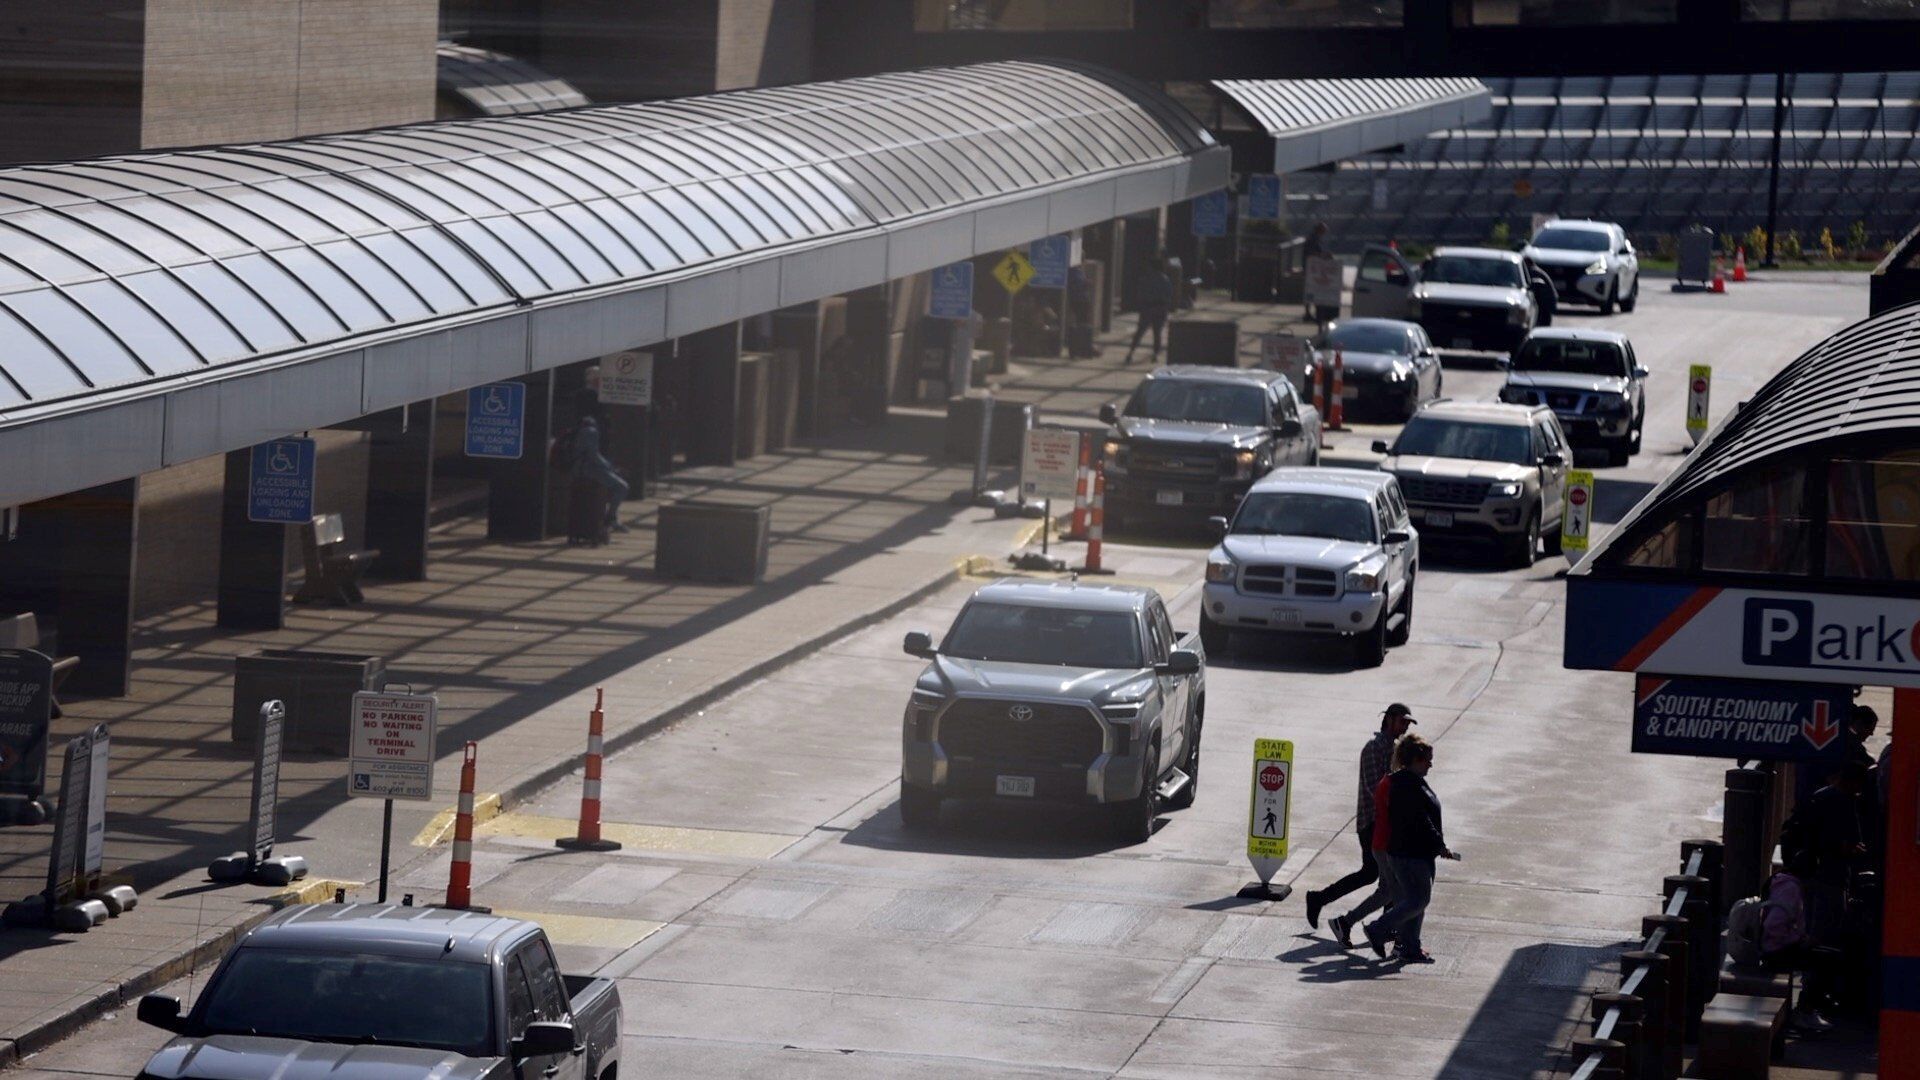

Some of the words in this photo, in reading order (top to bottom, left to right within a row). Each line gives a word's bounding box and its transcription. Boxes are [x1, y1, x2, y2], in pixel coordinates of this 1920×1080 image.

[256, 477, 307, 488] ACCESSIBLE
[252, 487, 289, 498] LOADING
[293, 489, 310, 498] AND
[256, 498, 305, 508] UNLOADING
[268, 508, 293, 519] ZONE
[1760, 608, 1920, 663] Park
[20, 683, 40, 694] APP
[362, 700, 398, 708] SECURITY
[1653, 694, 1710, 717] SOUTH
[1712, 698, 1799, 722] ECONOMY
[362, 711, 376, 719] NO
[381, 712, 424, 722] PARKING
[0, 722, 33, 736] ARAGE
[382, 722, 422, 731] WAITING
[1646, 715, 1661, 735] &
[1664, 717, 1733, 740] CANOPY
[1735, 720, 1799, 744] PICKUP
[368, 738, 415, 748] TERMINAL
[1261, 741, 1287, 751] STATE
[377, 748, 406, 756] DRIVE
[1265, 750, 1282, 759] LAW
[1261, 773, 1284, 784] STOP
